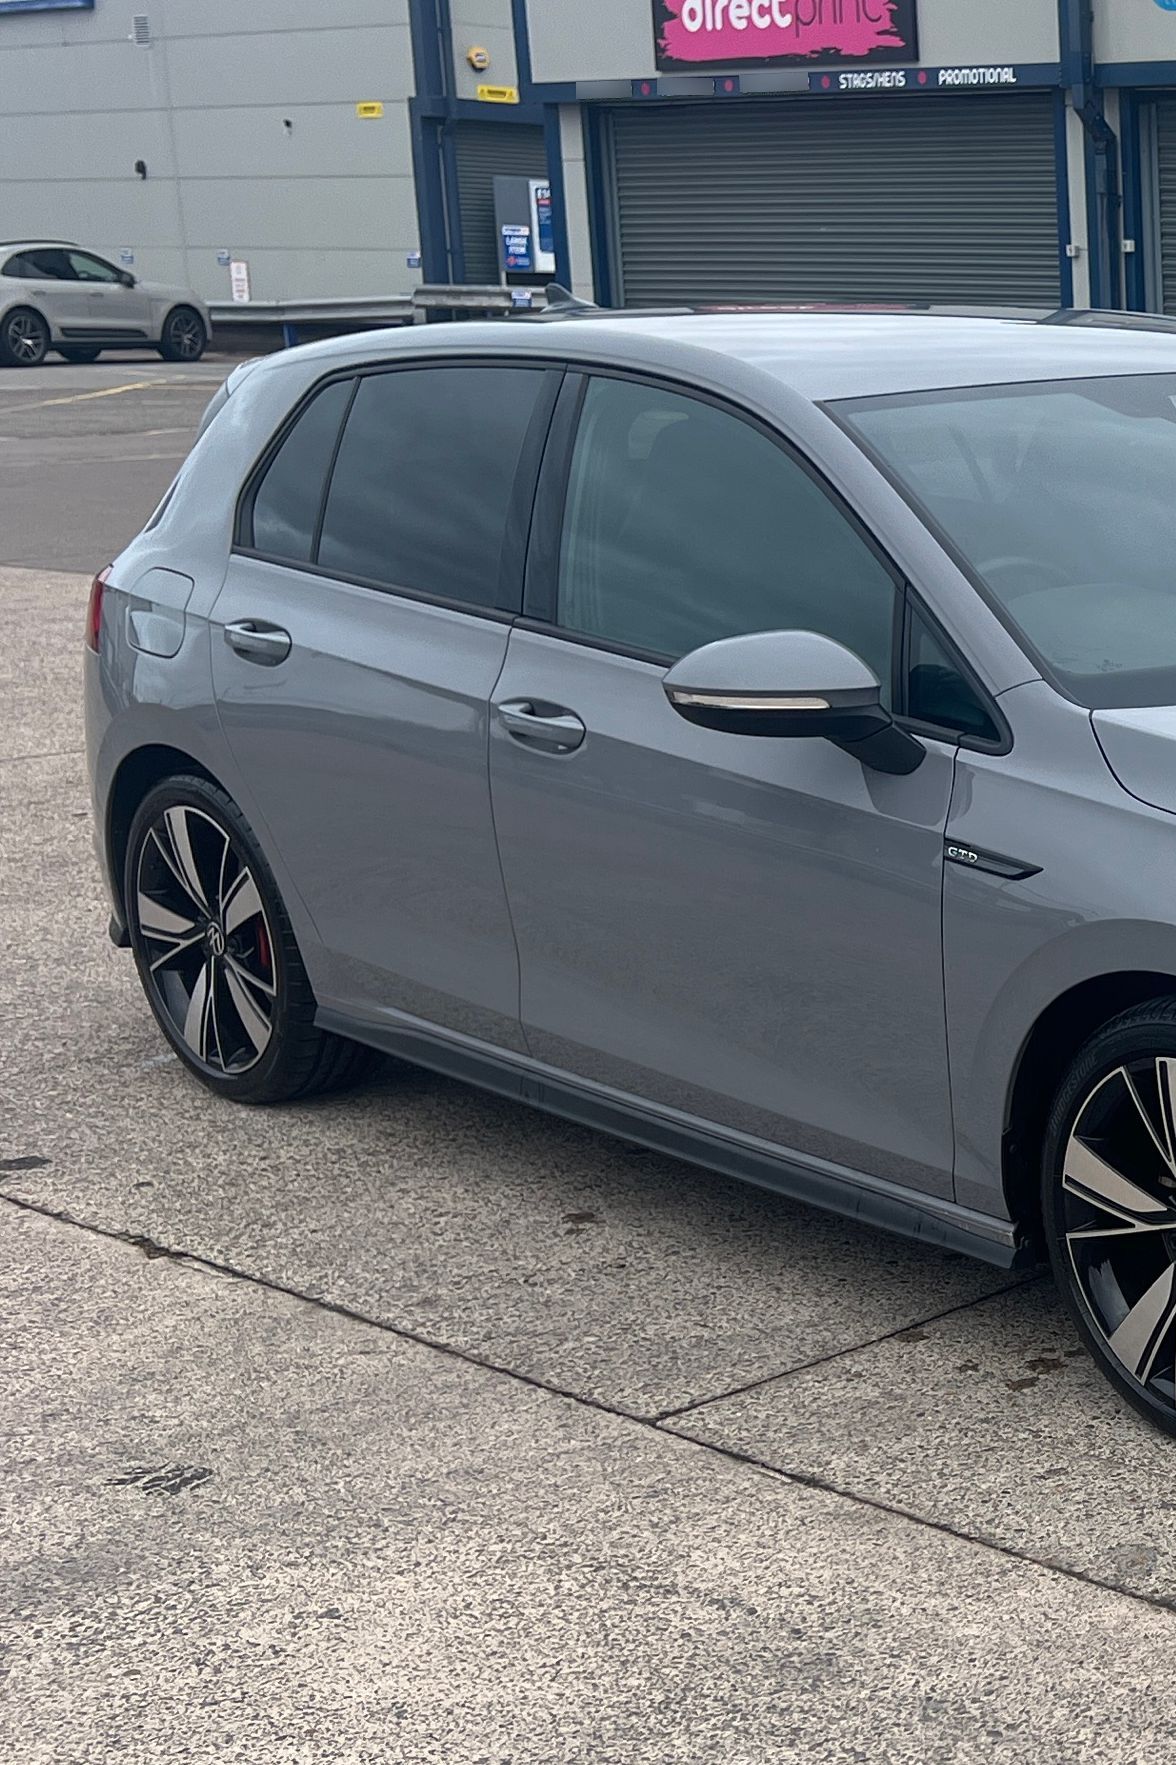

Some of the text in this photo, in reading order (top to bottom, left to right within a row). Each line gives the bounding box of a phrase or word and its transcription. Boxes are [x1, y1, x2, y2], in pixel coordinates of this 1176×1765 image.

[838, 71, 906, 89] STAGS/HENS
[938, 67, 1017, 86] PROMOTIONAL
[948, 846, 978, 862] GTD
